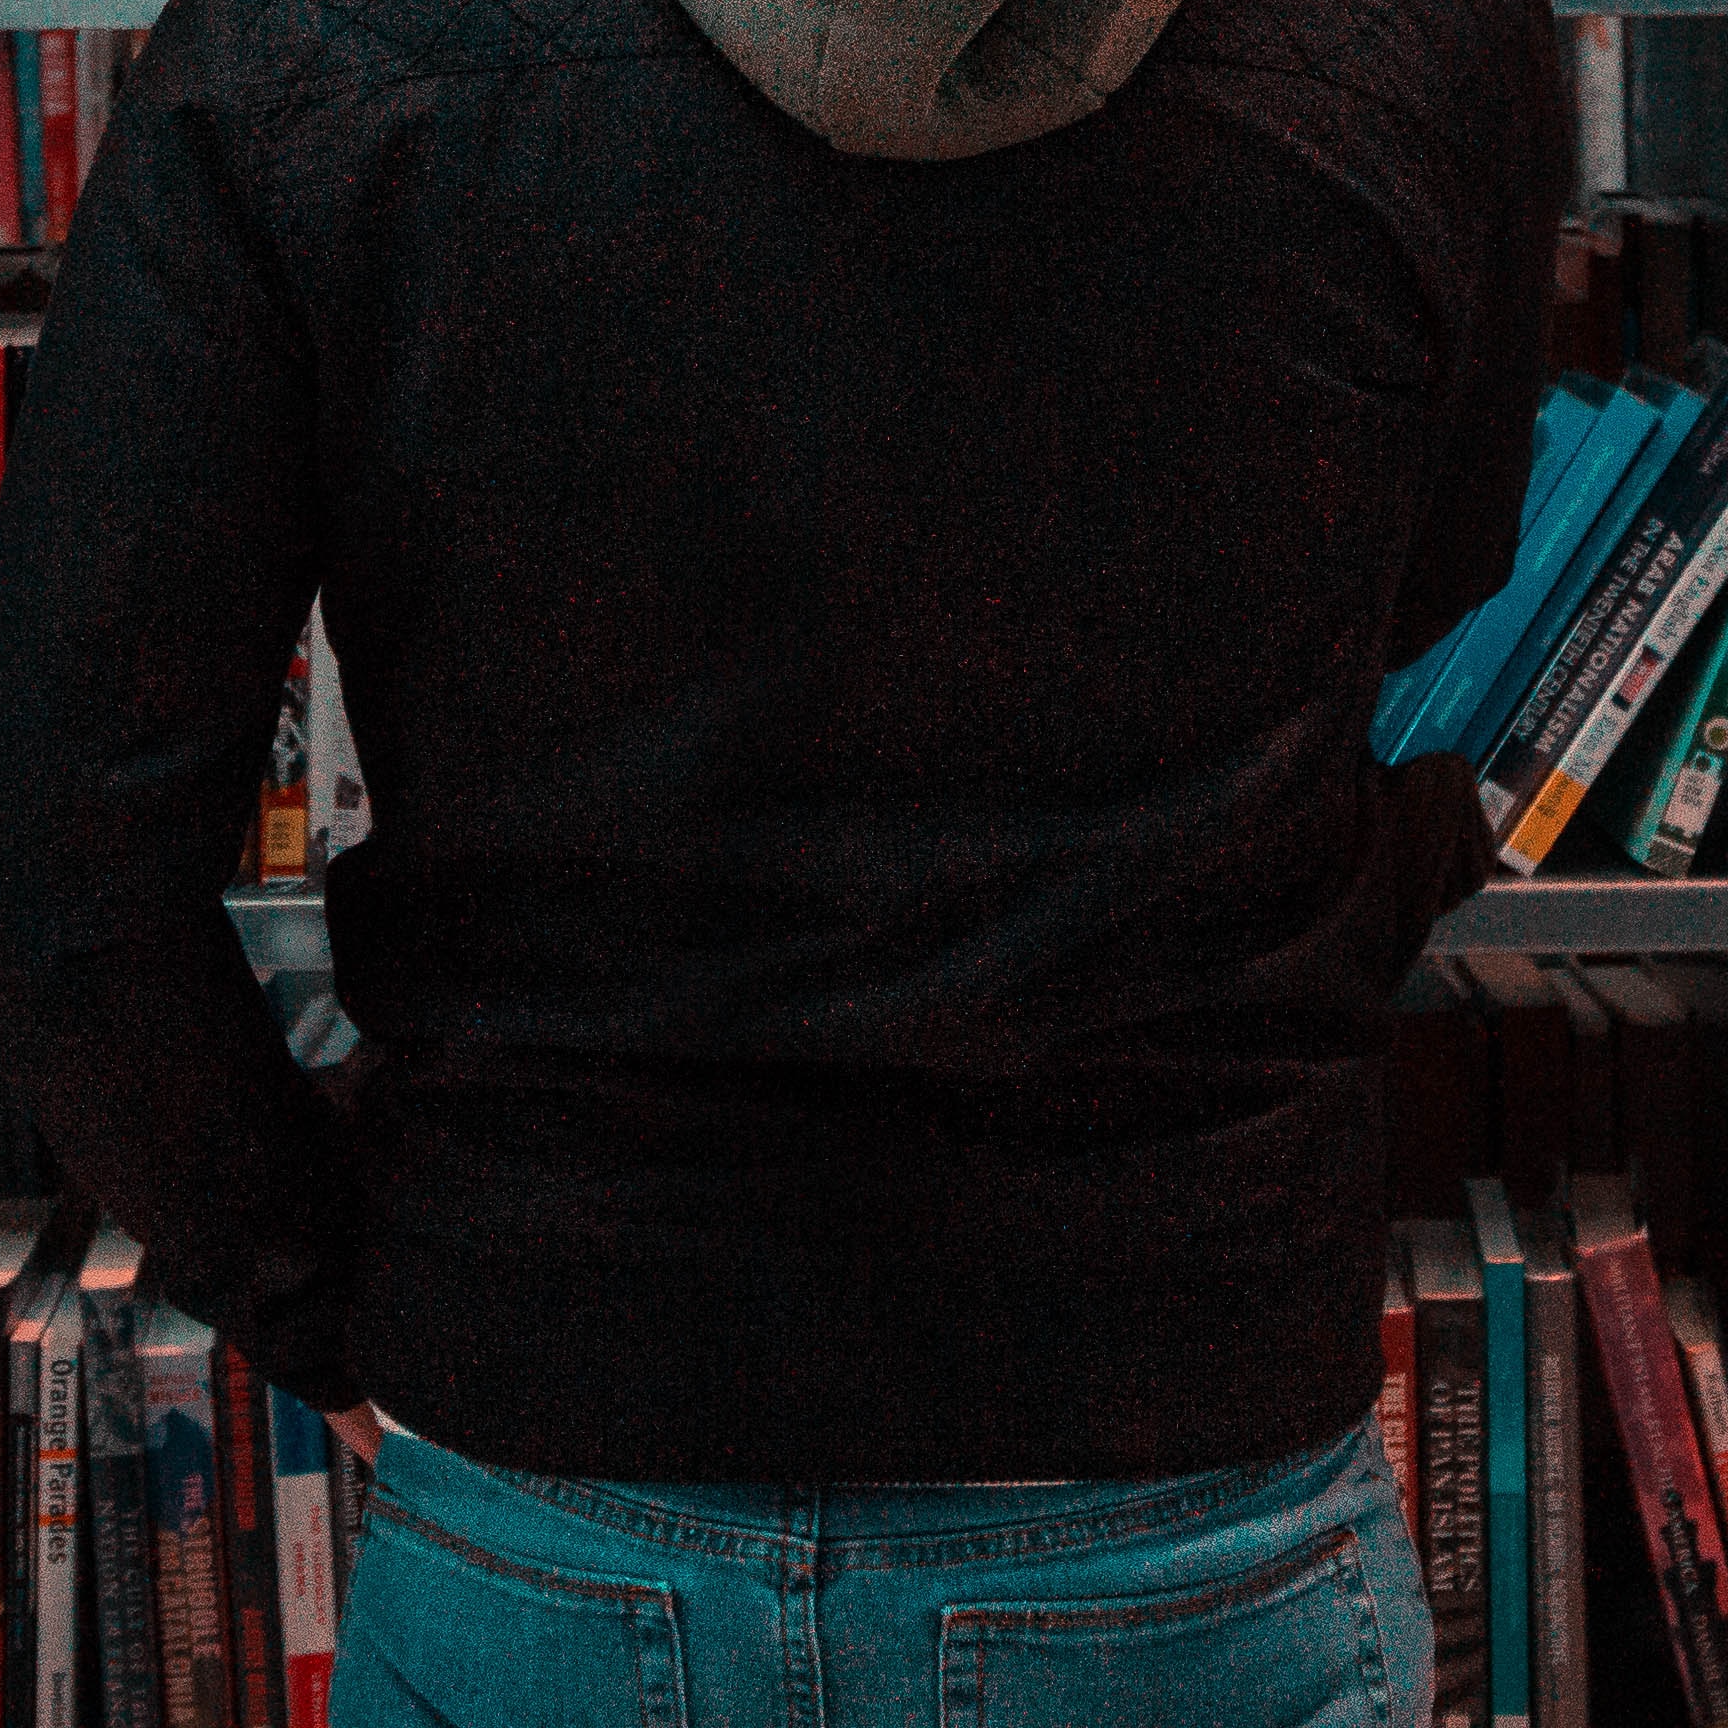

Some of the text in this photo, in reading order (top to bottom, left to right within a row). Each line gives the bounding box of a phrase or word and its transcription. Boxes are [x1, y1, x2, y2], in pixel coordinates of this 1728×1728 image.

[1533, 531, 1684, 752] ARAB NATIONALISM
[47, 1359, 73, 1563] Orange Parades
